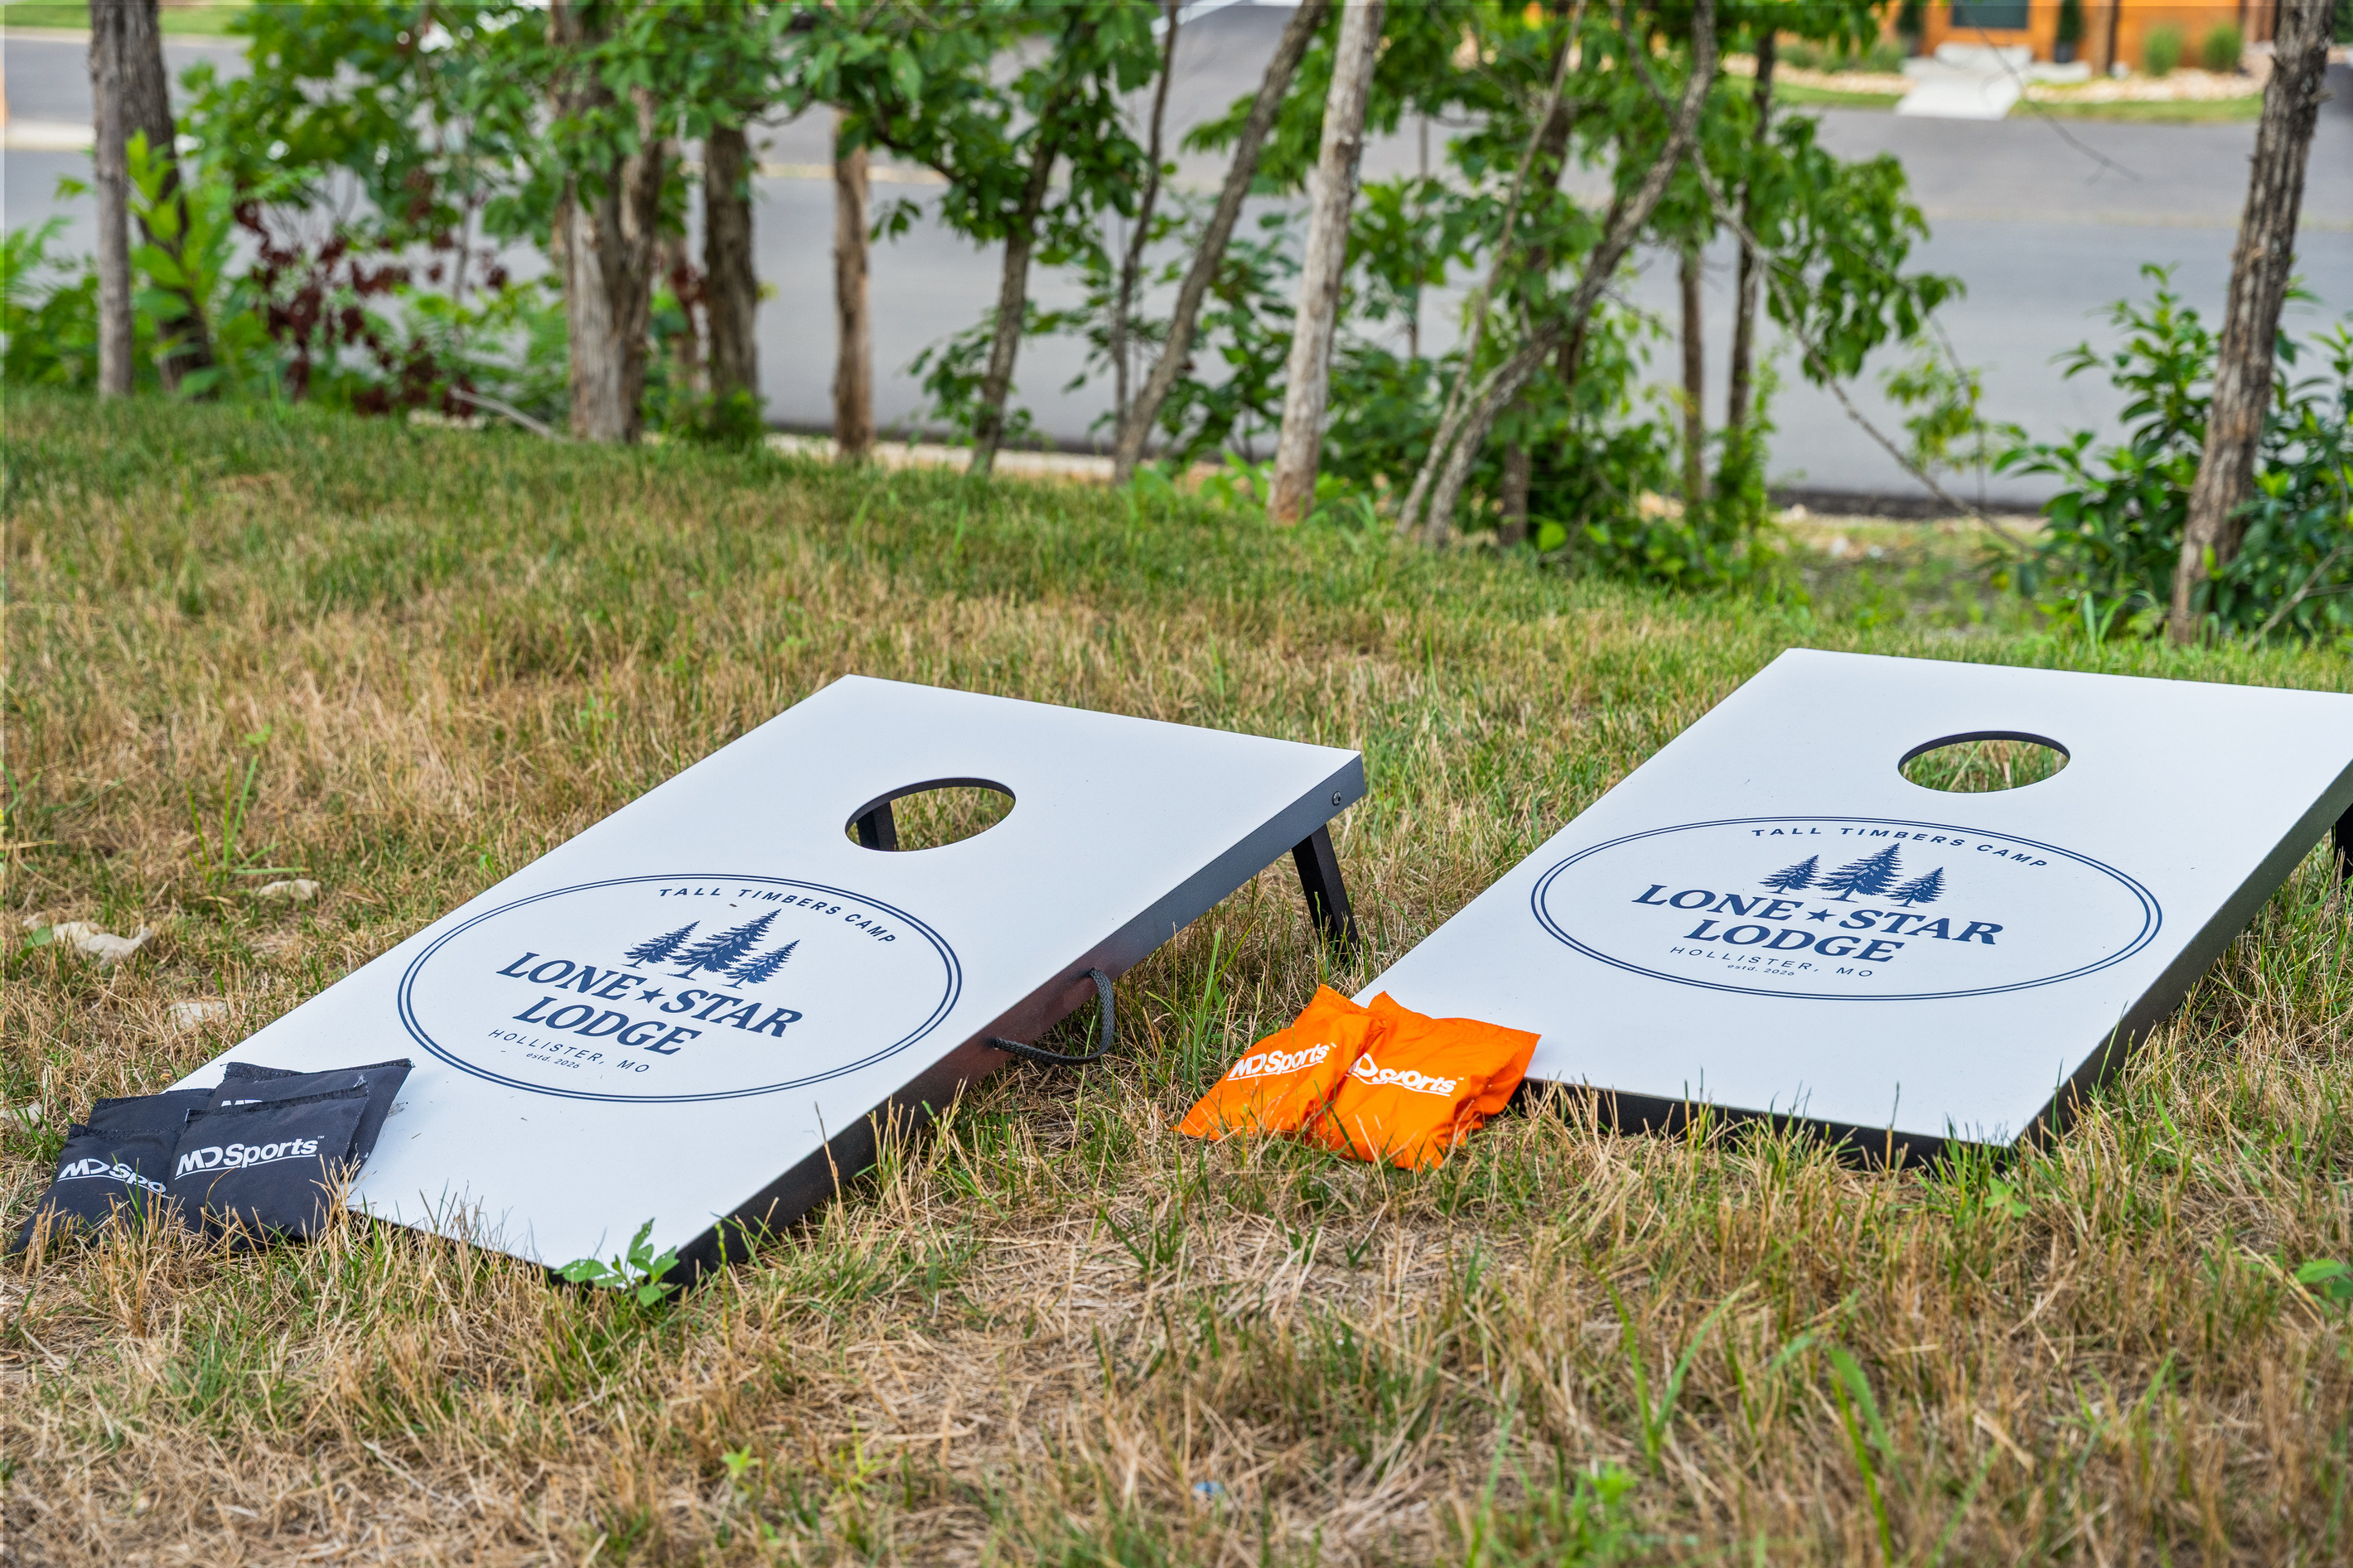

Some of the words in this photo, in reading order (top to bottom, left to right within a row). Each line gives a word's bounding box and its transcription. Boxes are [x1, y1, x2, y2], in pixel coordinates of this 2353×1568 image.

[1751, 827, 1822, 837] TALL
[1840, 827, 1965, 847] TIMBERS
[1976, 844, 2047, 867] CAMP
[659, 887, 721, 897] TALL
[737, 889, 842, 915] TIMBERS
[844, 914, 896, 943] CAMP
[1631, 884, 1805, 921] LONE
[1838, 909, 2004, 945] STAR
[1669, 946, 1819, 972] HOLLISTER,
[1835, 967, 1873, 977] MO
[1683, 919, 1905, 963] LODGE
[1727, 963, 1757, 972] estd.
[1763, 967, 1795, 977] 2026
[495, 952, 648, 1001] LONE
[660, 989, 803, 1038] STAR
[512, 996, 703, 1055] LODGE
[487, 1029, 605, 1065] HOLLISTER,
[616, 1059, 650, 1073] MO
[526, 1051, 551, 1062] estd.
[554, 1059, 581, 1069] 2026
[58, 1158, 167, 1194] MDSpo
